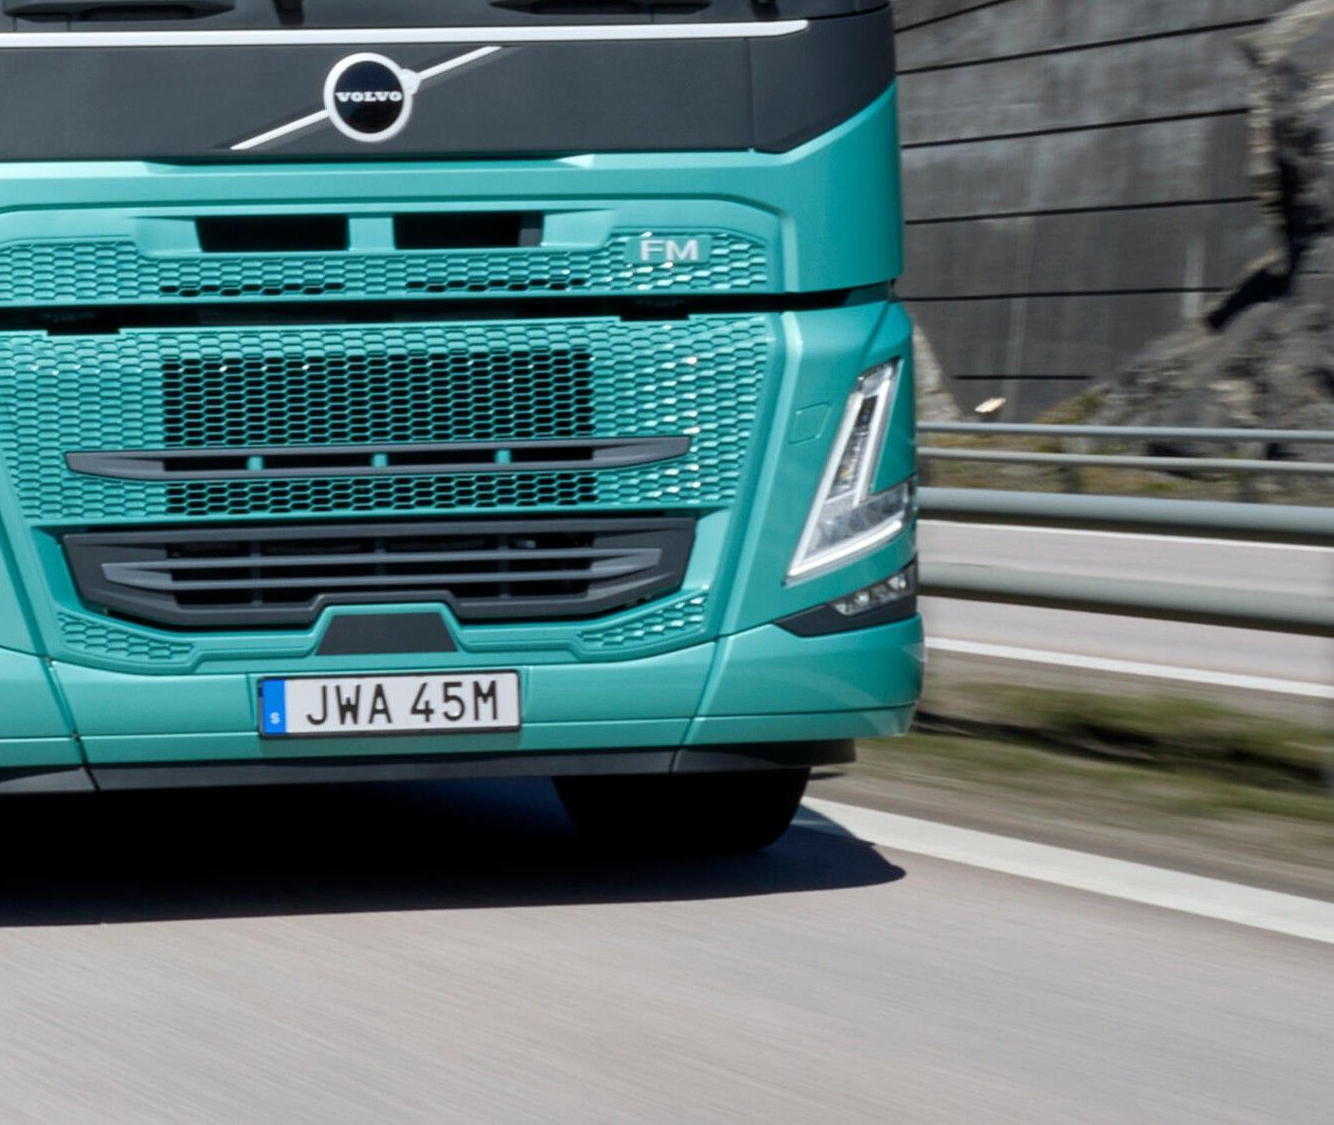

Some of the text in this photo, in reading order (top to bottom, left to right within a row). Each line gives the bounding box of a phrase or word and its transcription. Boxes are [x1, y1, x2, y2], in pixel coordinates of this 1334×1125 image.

[334, 90, 403, 103] VOLVO
[640, 239, 698, 262] FM
[306, 680, 499, 725] JWA 45M
[270, 712, 281, 724] S
